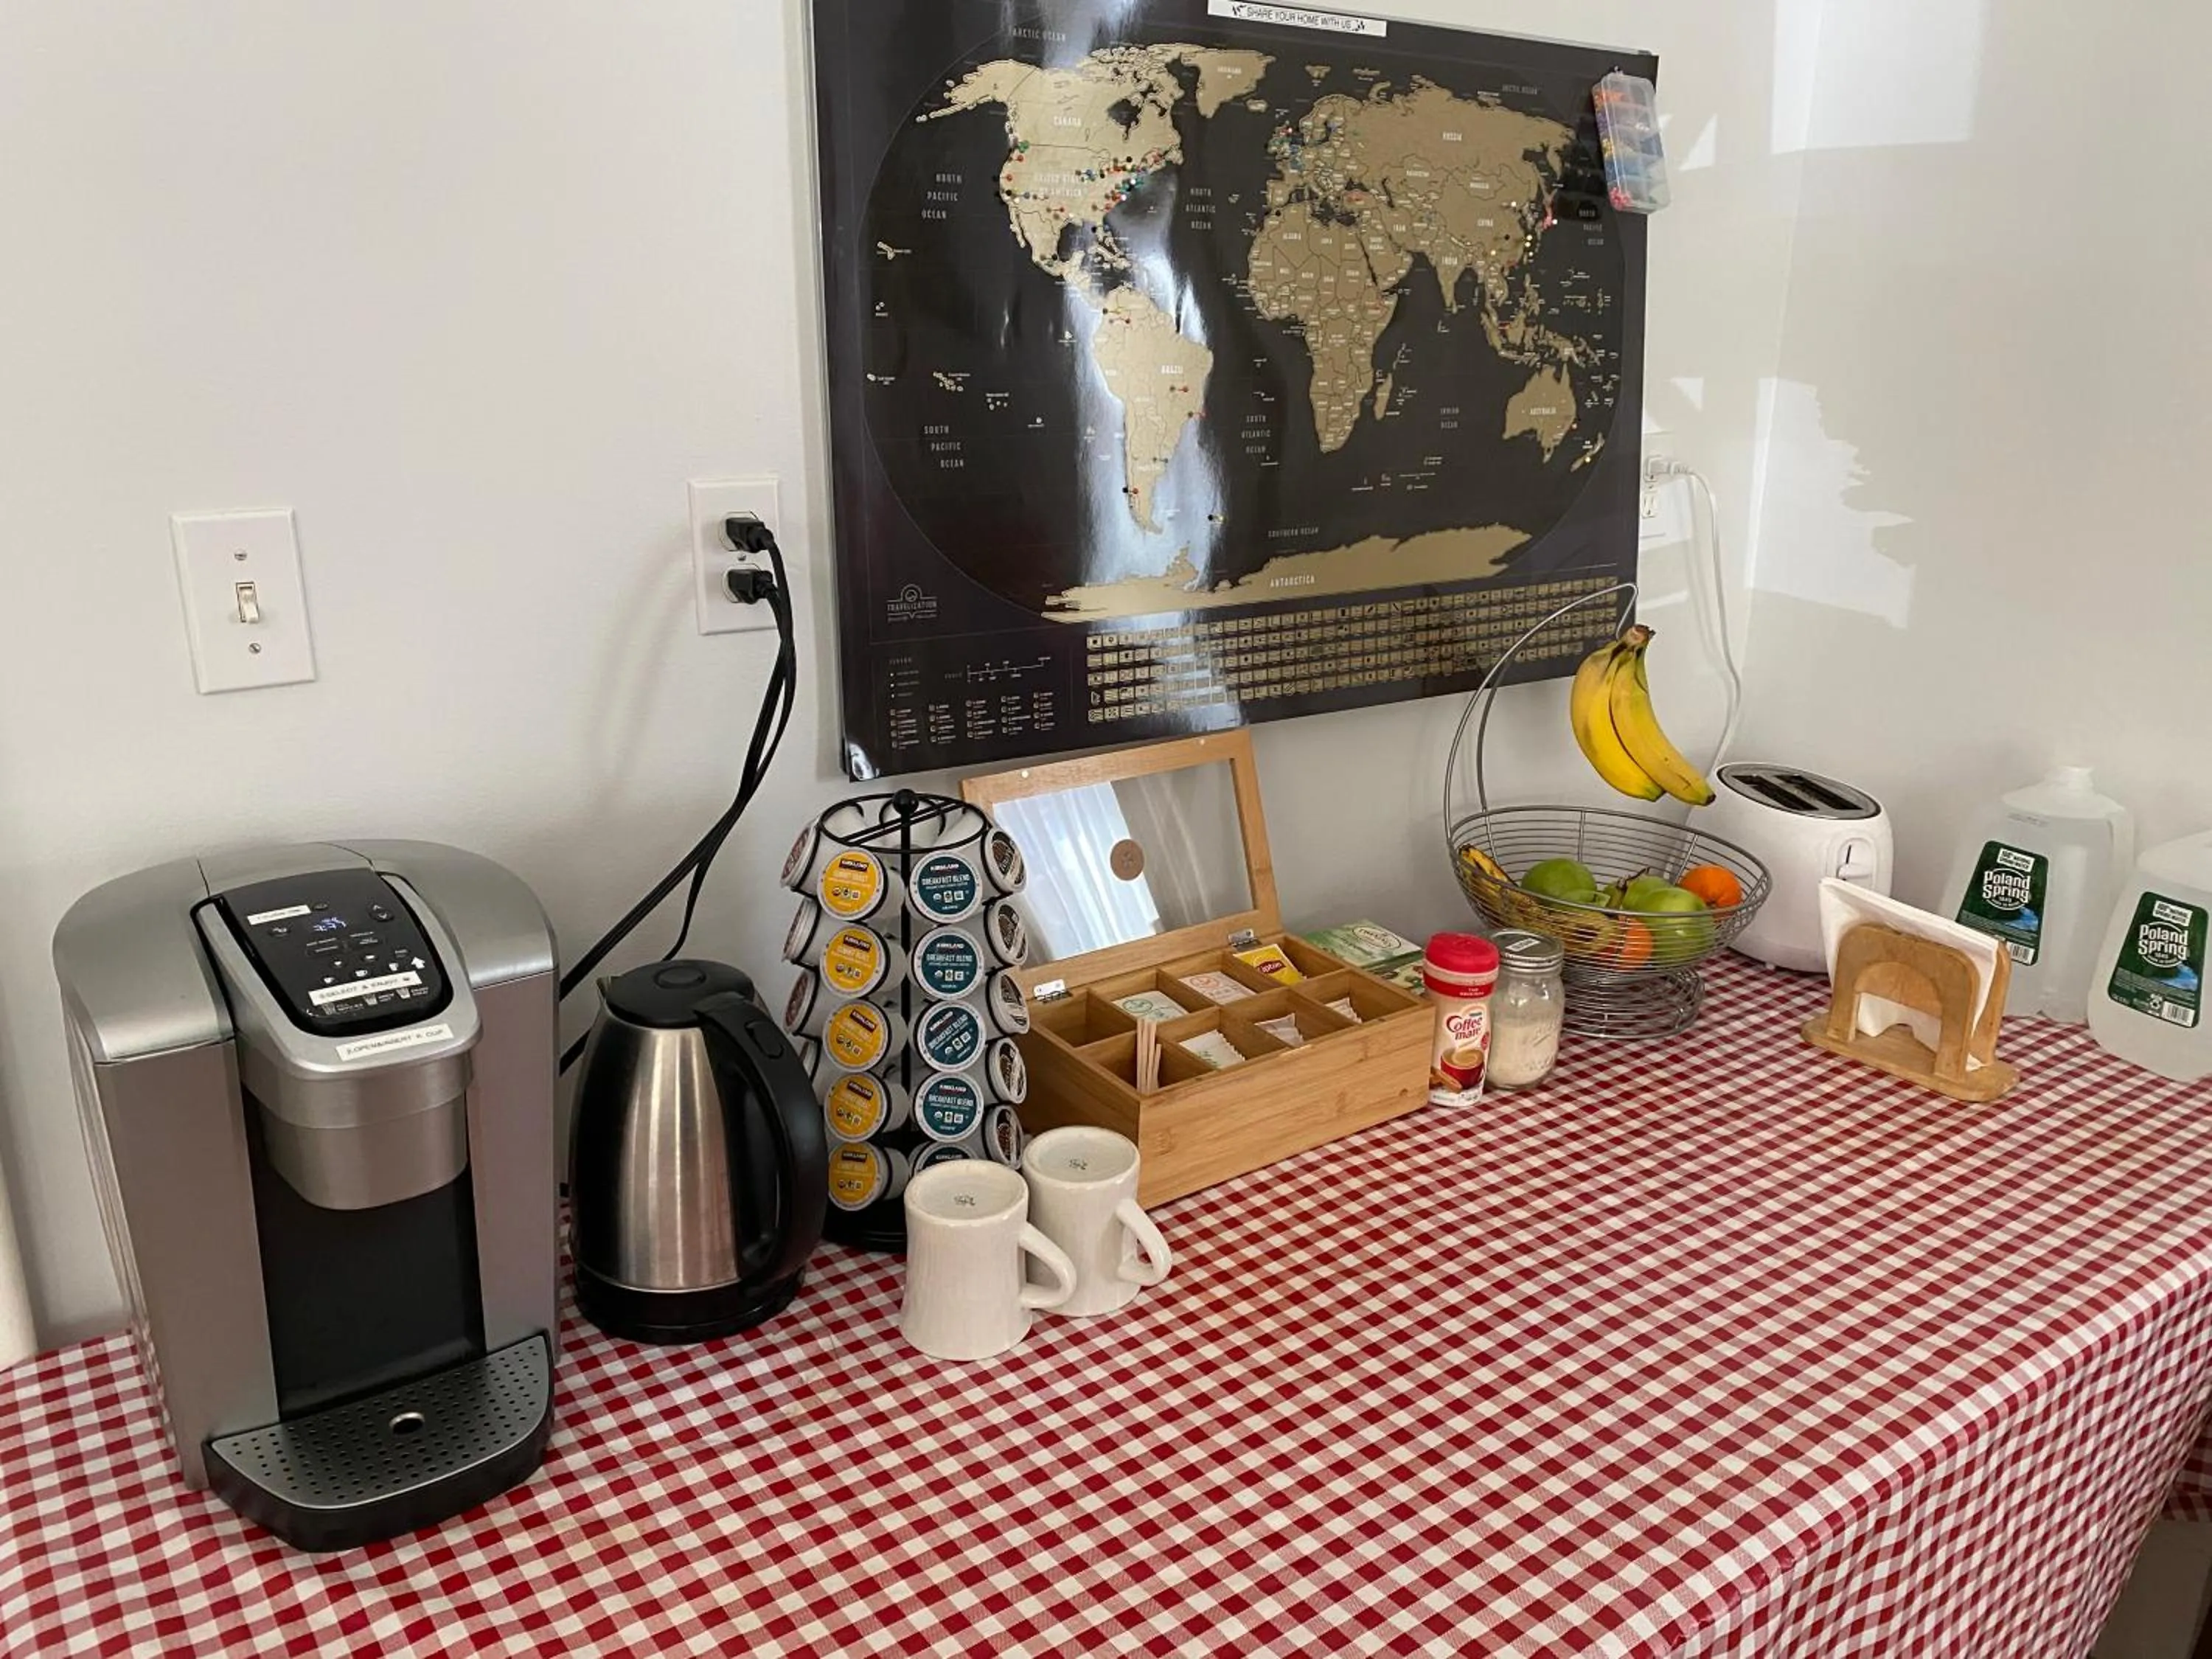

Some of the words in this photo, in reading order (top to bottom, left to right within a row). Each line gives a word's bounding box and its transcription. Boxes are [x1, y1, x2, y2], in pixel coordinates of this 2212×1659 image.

[1247, 7, 1273, 20] SHARE
[1275, 10, 1295, 22] YOUR
[1297, 13, 1320, 26] HOME
[1321, 16, 1340, 27] WITH
[1341, 18, 1352, 29] US
[927, 191, 959, 202] PACIFIC
[1270, 575, 1315, 588] ANTARCTICA
[1983, 871, 2031, 889] Poland
[1983, 884, 2029, 903] Spring
[2139, 924, 2188, 946] Poland
[2138, 939, 2188, 961] Spring
[1446, 1015, 1483, 1033] Coffee
